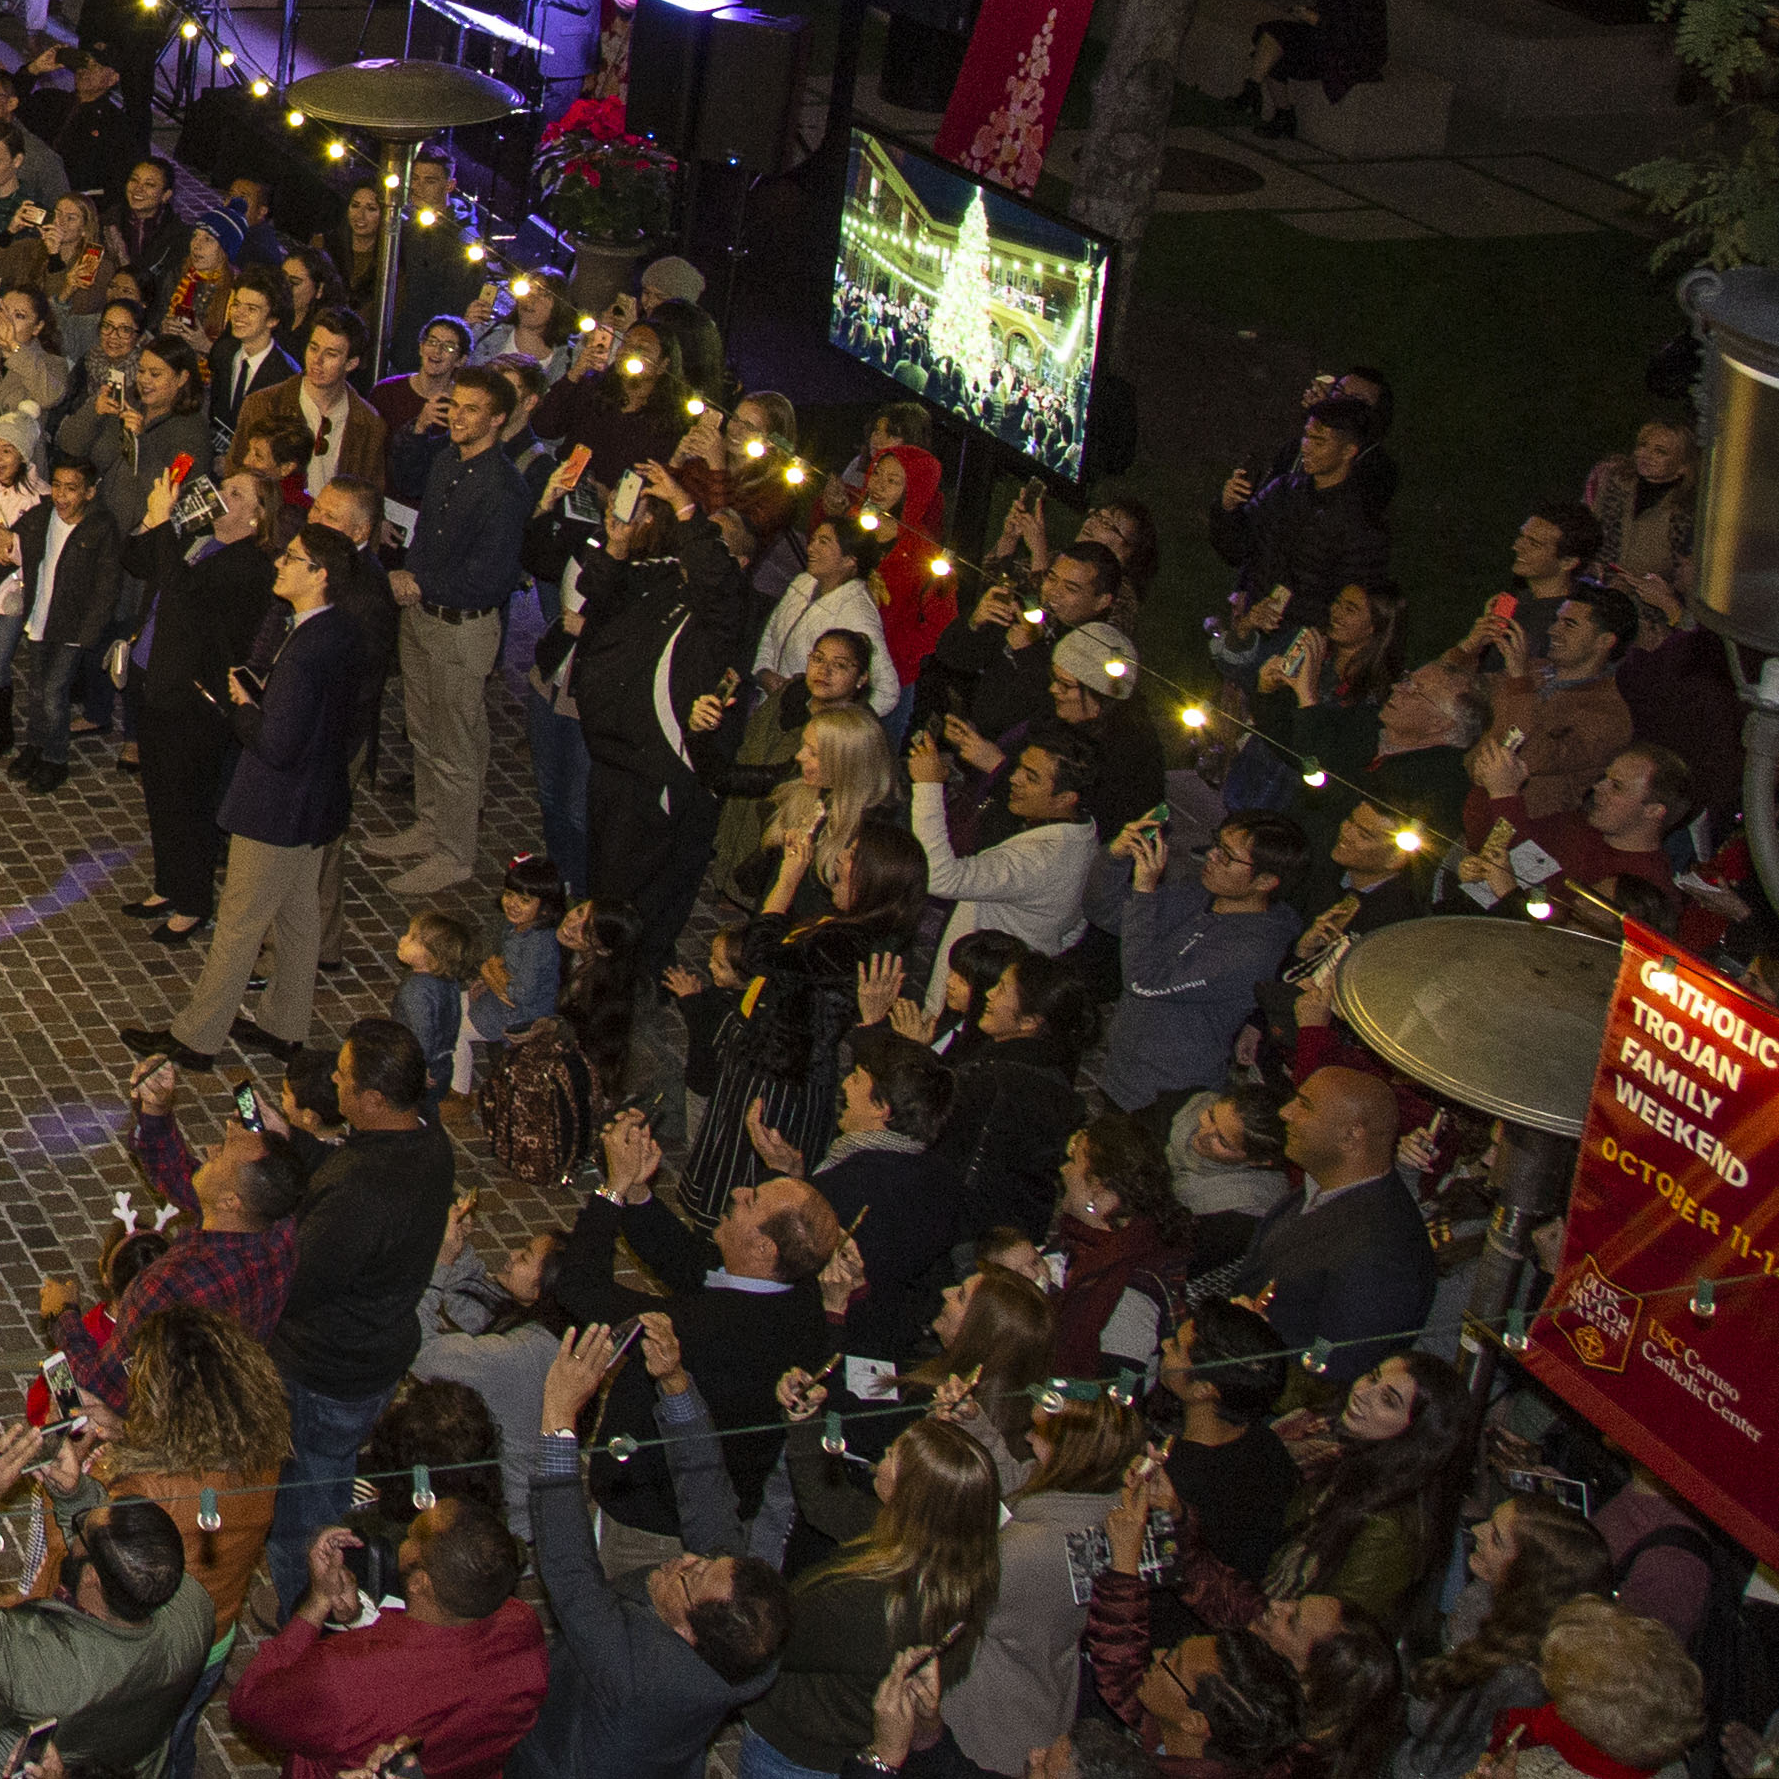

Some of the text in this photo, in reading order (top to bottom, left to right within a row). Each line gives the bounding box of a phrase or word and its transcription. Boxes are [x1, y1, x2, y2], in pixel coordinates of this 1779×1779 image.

[1631, 996, 1743, 1092] TROJAN
[1639, 959, 1779, 1069] CATHOLIC
[1620, 1036, 1722, 1121] FAMILY
[1614, 1073, 1750, 1189] WEEKEND
[1601, 1136, 1721, 1236] OCTOBER
[1730, 1224, 1779, 1278] 11-1
[1583, 1271, 1621, 1310] OUR
[1641, 1340, 1763, 1443] Catholic Center
[1649, 1317, 1739, 1402] USC Caruso
